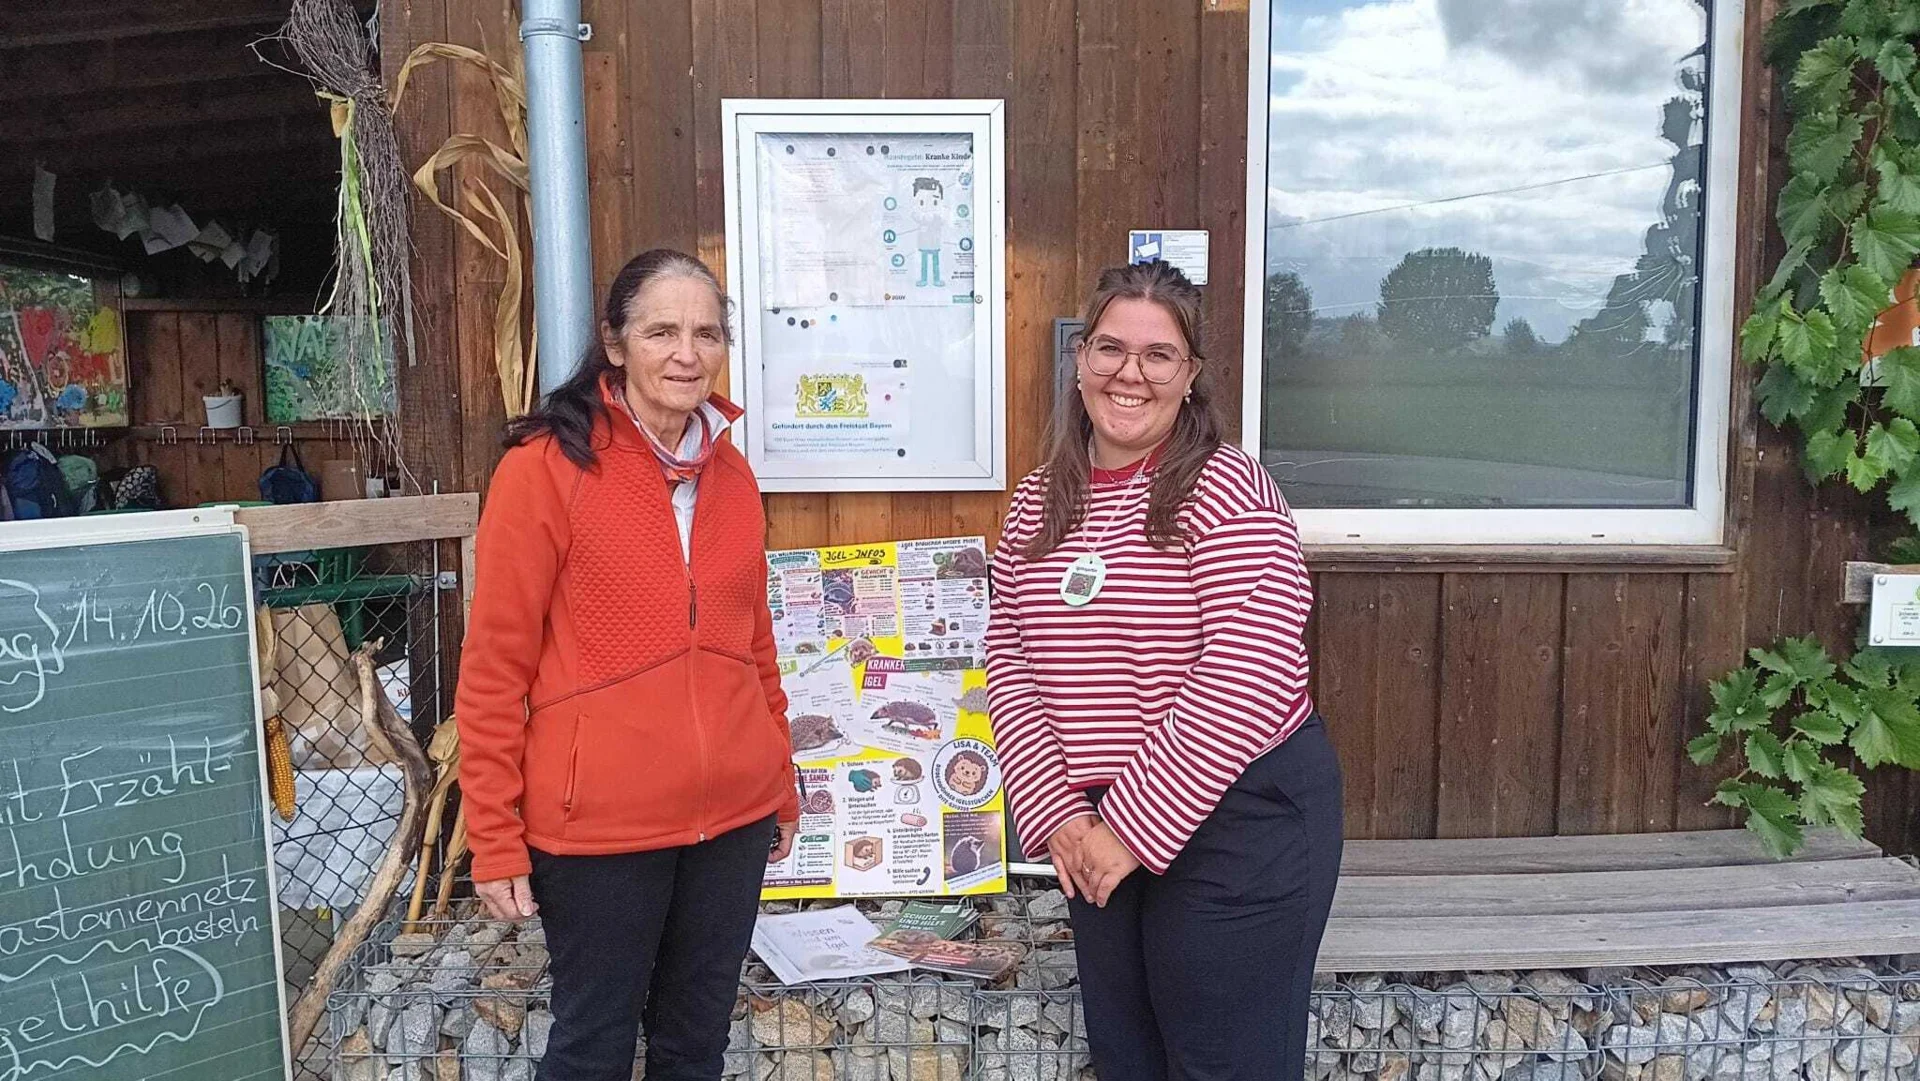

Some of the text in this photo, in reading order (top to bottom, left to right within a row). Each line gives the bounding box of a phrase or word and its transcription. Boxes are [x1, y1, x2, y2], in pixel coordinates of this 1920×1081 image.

[925, 153, 950, 161] Kranke
[864, 676, 883, 687] IGEL
[953, 741, 999, 768] LISA & TEAM
[899, 917, 920, 925] UND
[903, 912, 940, 921] SCHUTZ
